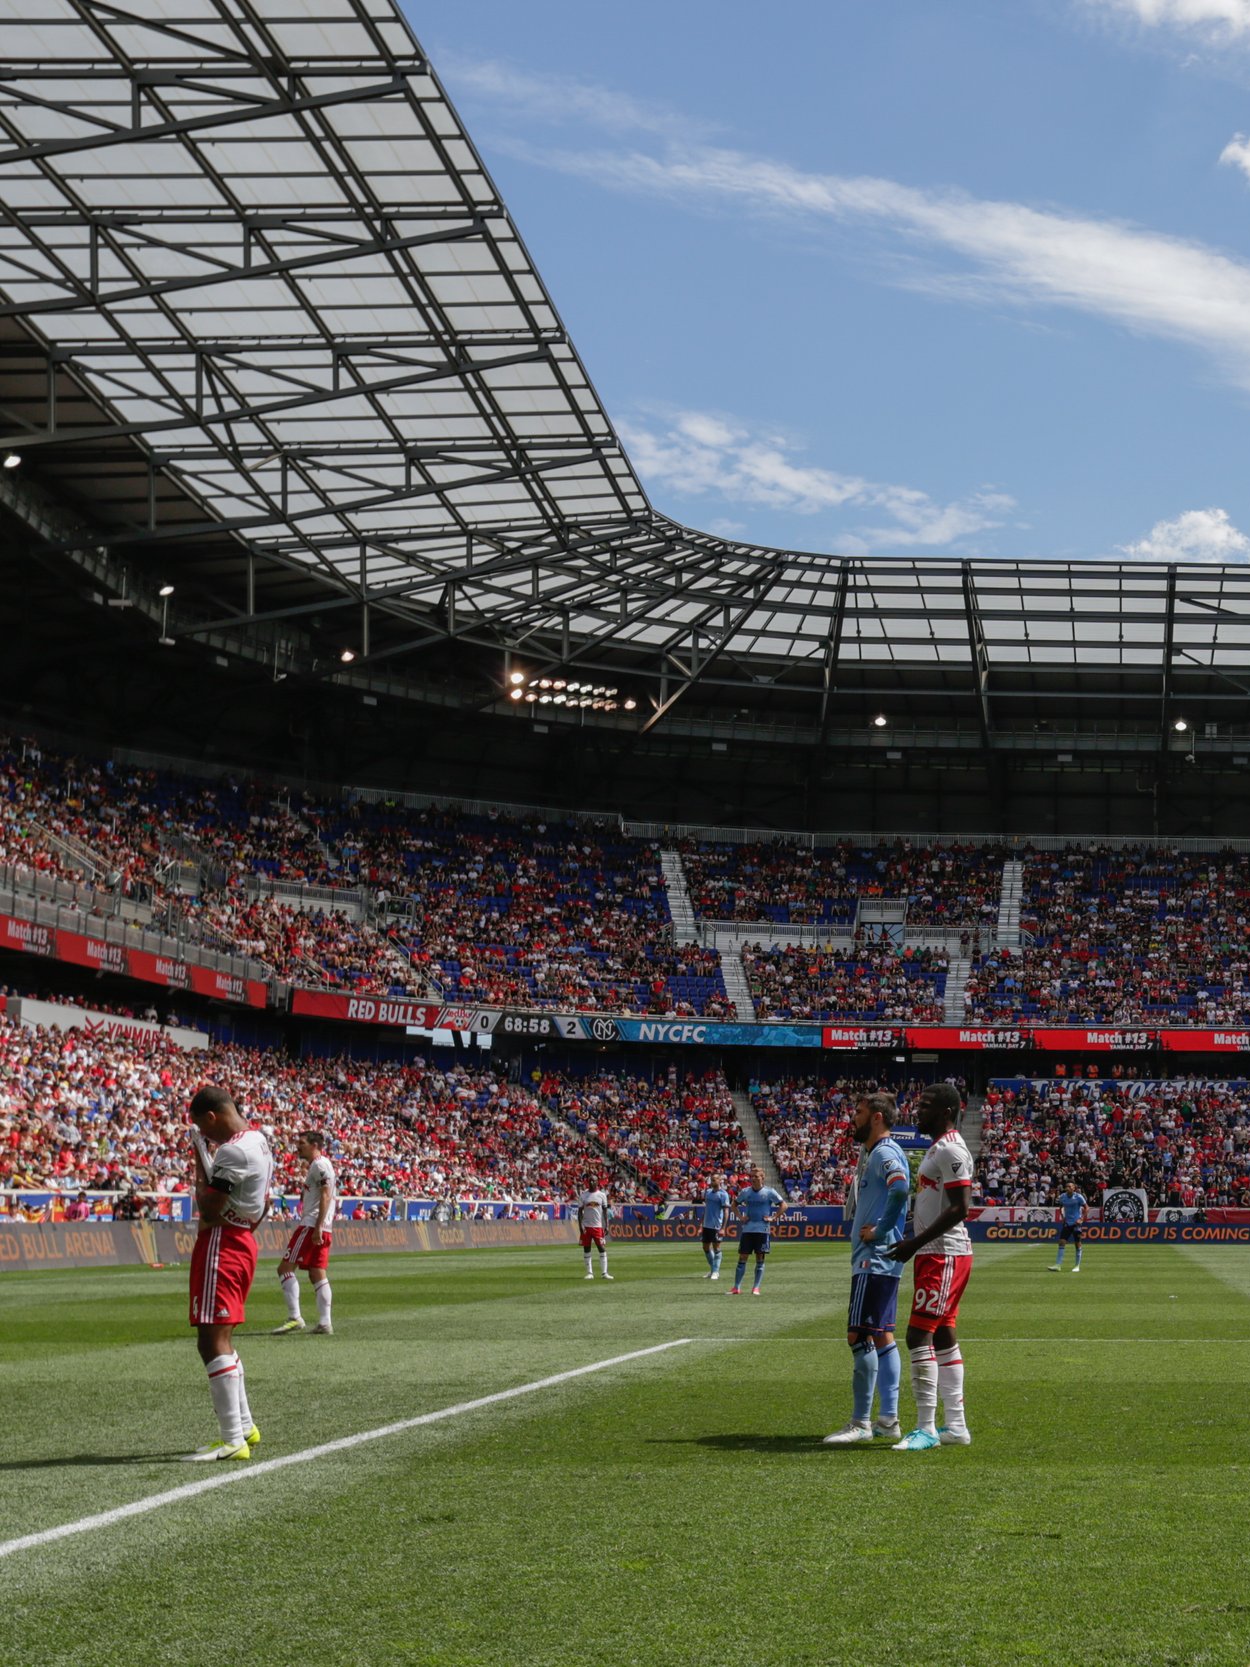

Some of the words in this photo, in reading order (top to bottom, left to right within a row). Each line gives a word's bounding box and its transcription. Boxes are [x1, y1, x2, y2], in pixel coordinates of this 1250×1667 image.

[8, 920, 31, 941] Match
[32, 926, 48, 945] #13
[87, 940, 108, 961] Match
[108, 946, 121, 963] #13
[156, 959, 174, 977] Match
[216, 974, 232, 991] Match
[347, 999, 375, 1020] RED
[378, 1003, 426, 1026] BULLS
[480, 1015, 489, 1029] 0
[504, 1017, 551, 1034] 68:58
[567, 1021, 577, 1035] 2
[639, 1022, 706, 1042] NYCFC
[832, 1030, 866, 1041] Match
[870, 1030, 892, 1041] #13
[960, 1031, 995, 1042] Match
[998, 1031, 1020, 1042] #13
[1088, 1032, 1122, 1043] Match
[1125, 1032, 1147, 1043] #13
[1214, 1033, 1249, 1044] Match
[1116, 1081, 1229, 1101] TOGTHER
[610, 1224, 633, 1238] GOLD
[635, 1224, 660, 1238] CUP
[663, 1225, 672, 1237] IS
[770, 1225, 800, 1238] RED
[805, 1225, 846, 1238] BULL
[1080, 1226, 1121, 1239] GOLD
[1125, 1226, 1160, 1239] CUP
[1163, 1227, 1177, 1239] IS
[1182, 1227, 1250, 1240] COMING
[21, 1233, 63, 1260] BULL
[915, 1287, 940, 1312] 92
